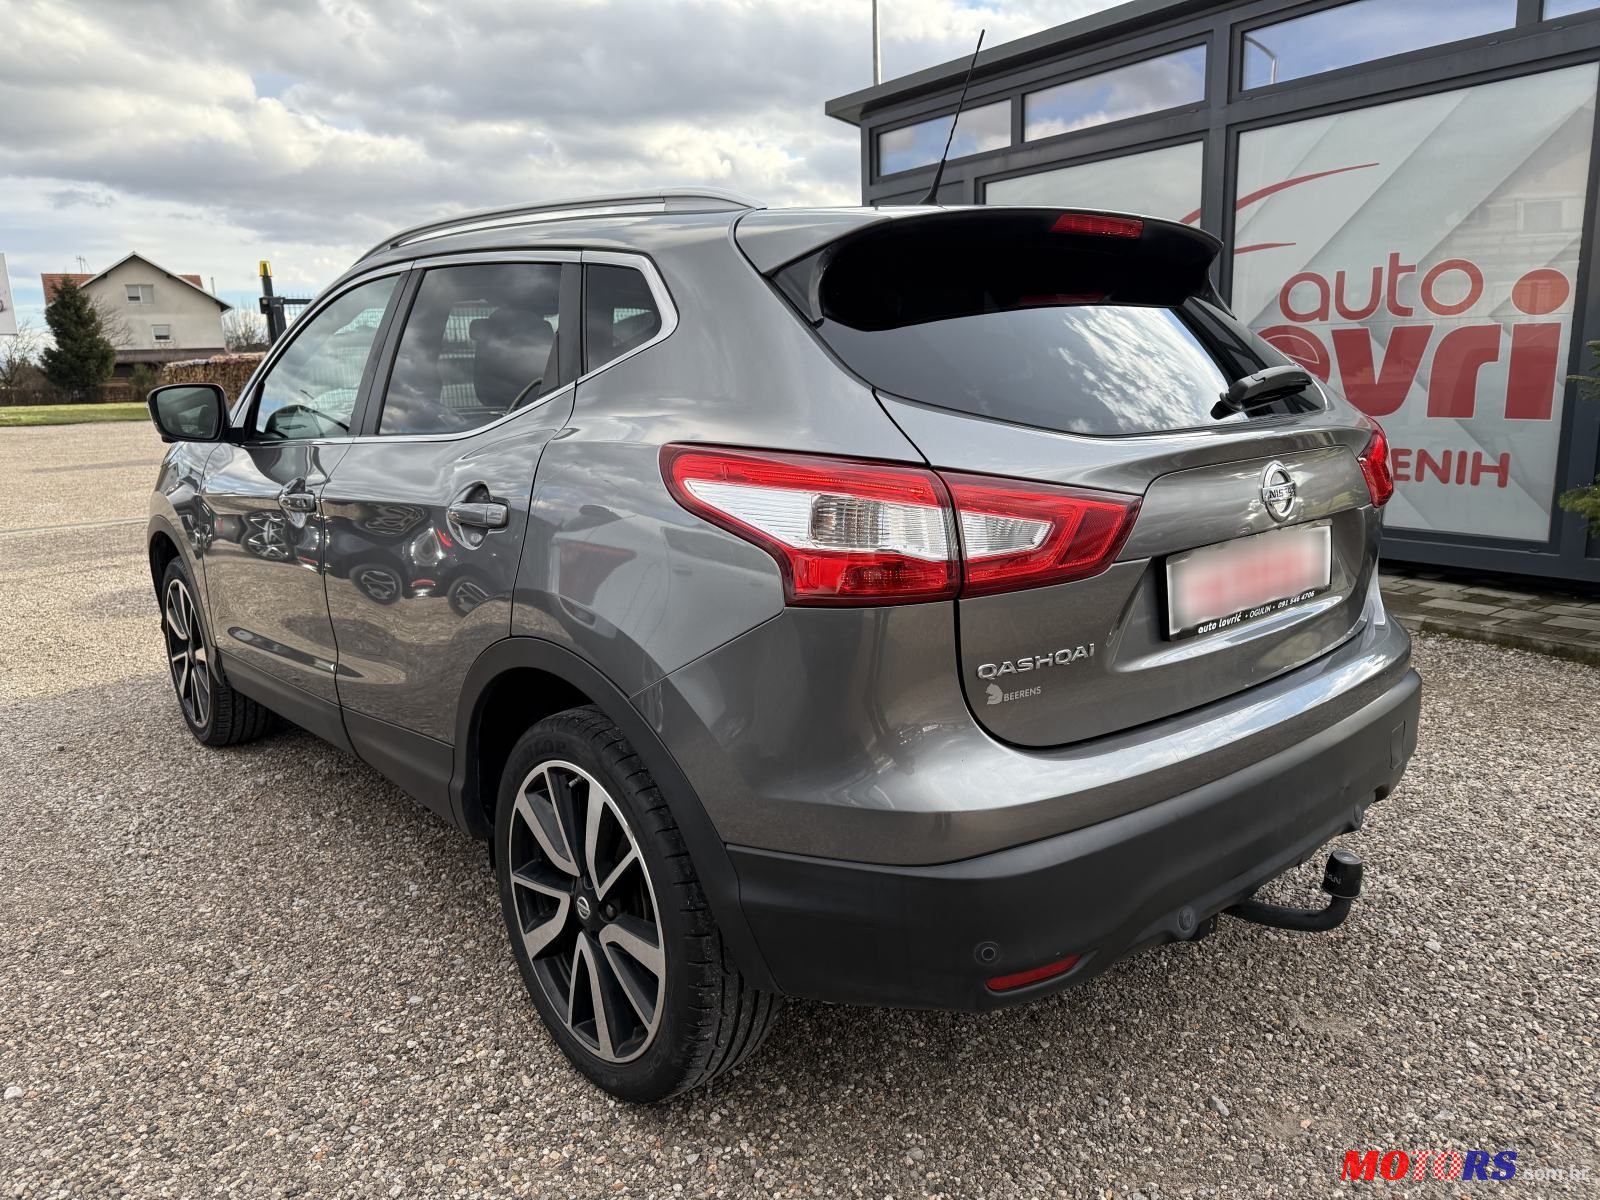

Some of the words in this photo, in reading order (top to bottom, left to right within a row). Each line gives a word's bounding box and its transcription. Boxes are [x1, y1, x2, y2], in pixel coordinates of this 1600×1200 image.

[1279, 252, 1484, 322] auto
[1390, 447, 1511, 488] ENIH
[1198, 622, 1217, 634] auto
[1219, 612, 1242, 628] lovrić
[1249, 605, 1272, 618] OGULIN
[977, 643, 1095, 680] QASHQAI
[1003, 686, 1042, 702] BEERENS
